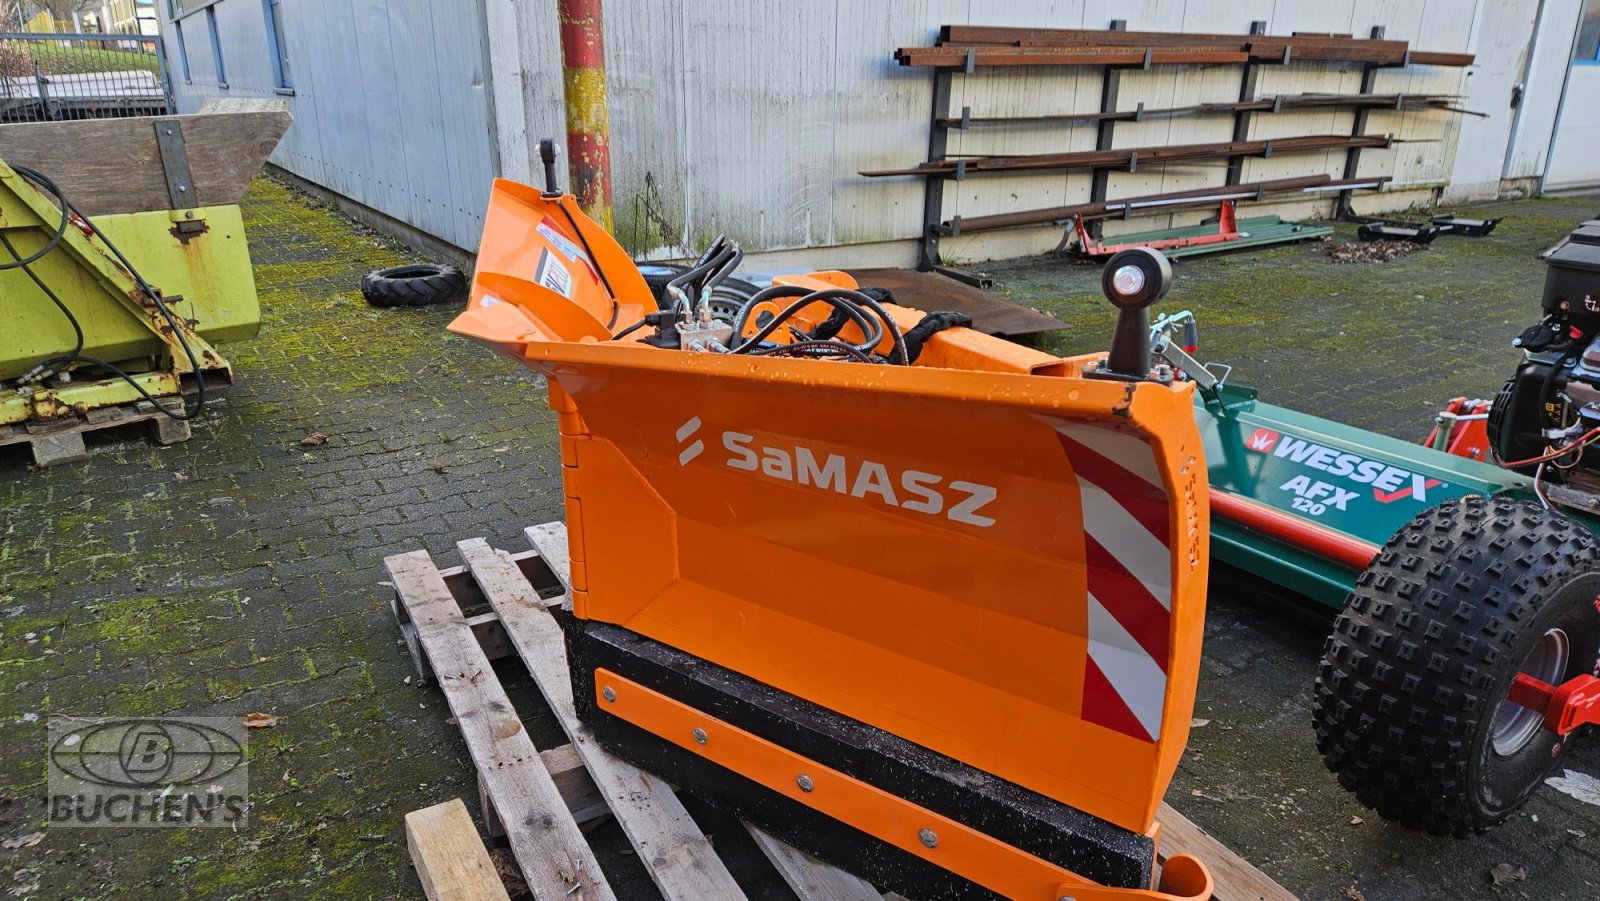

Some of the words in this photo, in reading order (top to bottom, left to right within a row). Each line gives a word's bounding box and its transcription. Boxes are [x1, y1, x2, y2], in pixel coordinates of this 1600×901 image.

[722, 430, 998, 528] SaMASZ
[1273, 435, 1444, 503] WESSEX
[1279, 474, 1361, 512] AFX
[1291, 497, 1327, 516] 120
